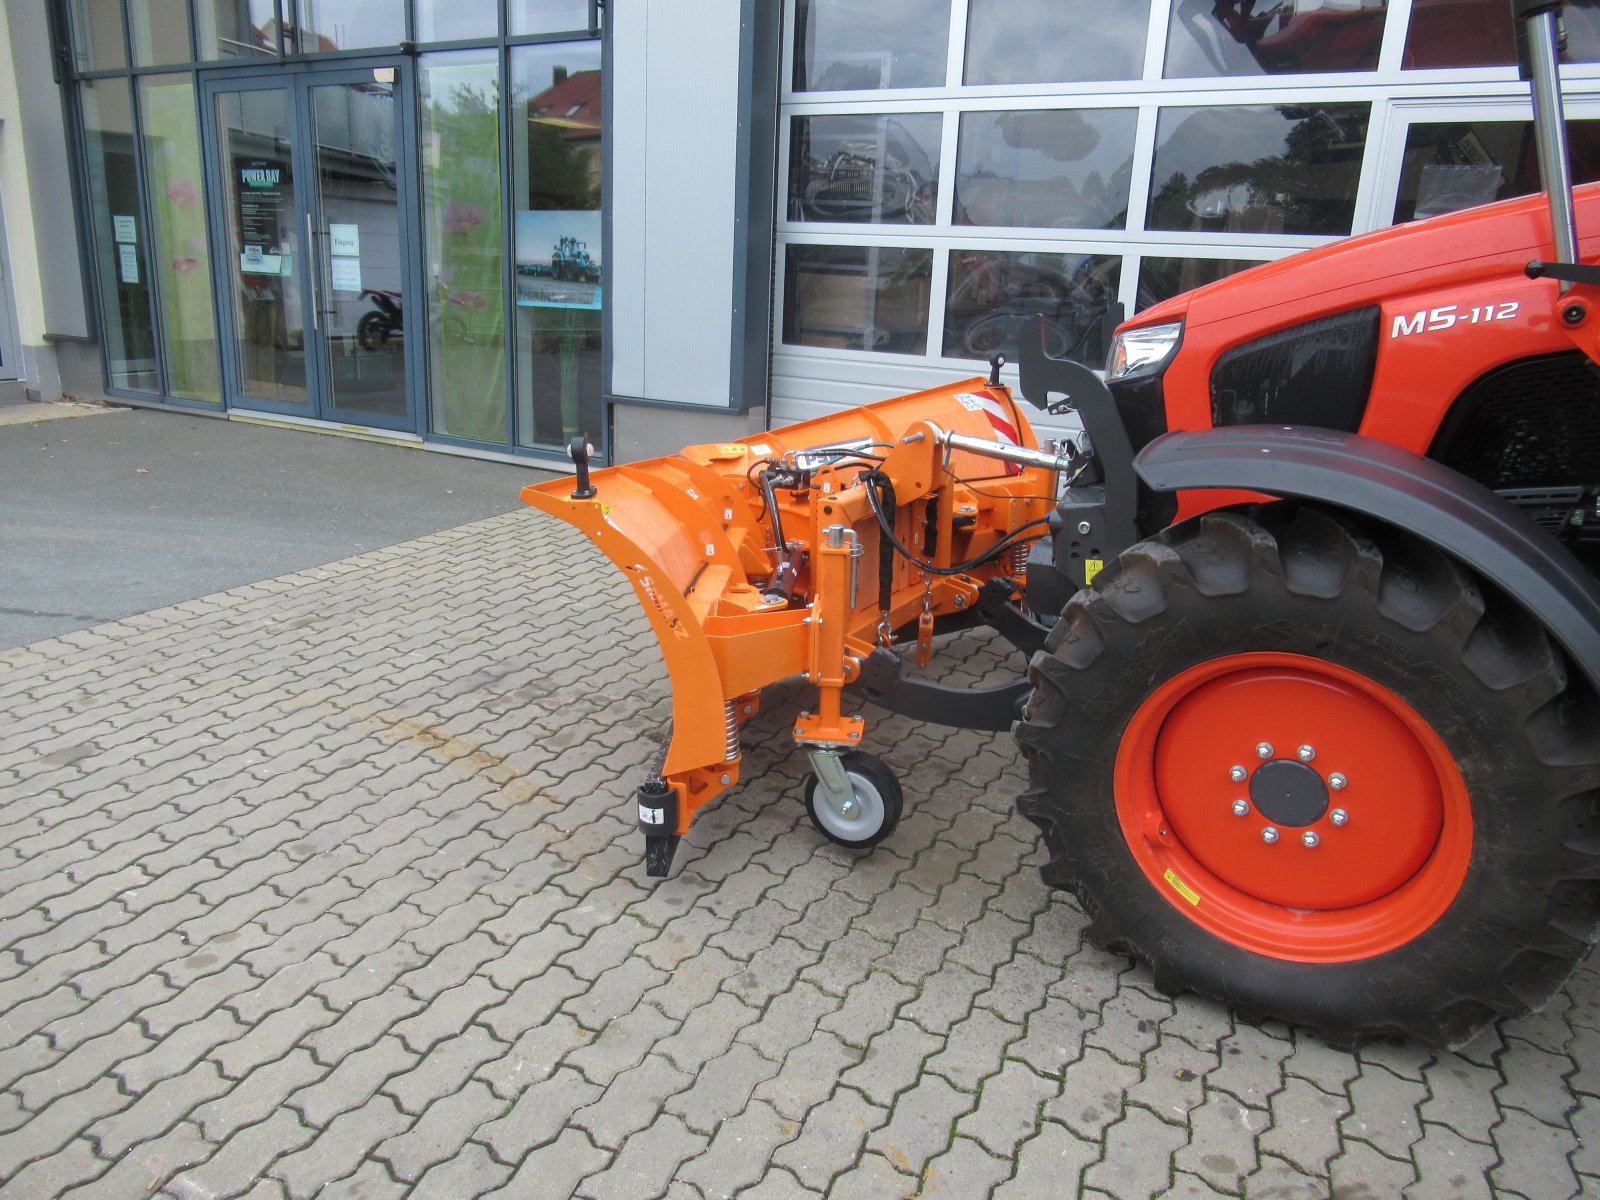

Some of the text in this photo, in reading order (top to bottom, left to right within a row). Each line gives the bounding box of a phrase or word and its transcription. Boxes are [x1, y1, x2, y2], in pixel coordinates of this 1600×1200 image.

[241, 169, 280, 183] POWER DAY
[1391, 302, 1519, 338] M5-112
